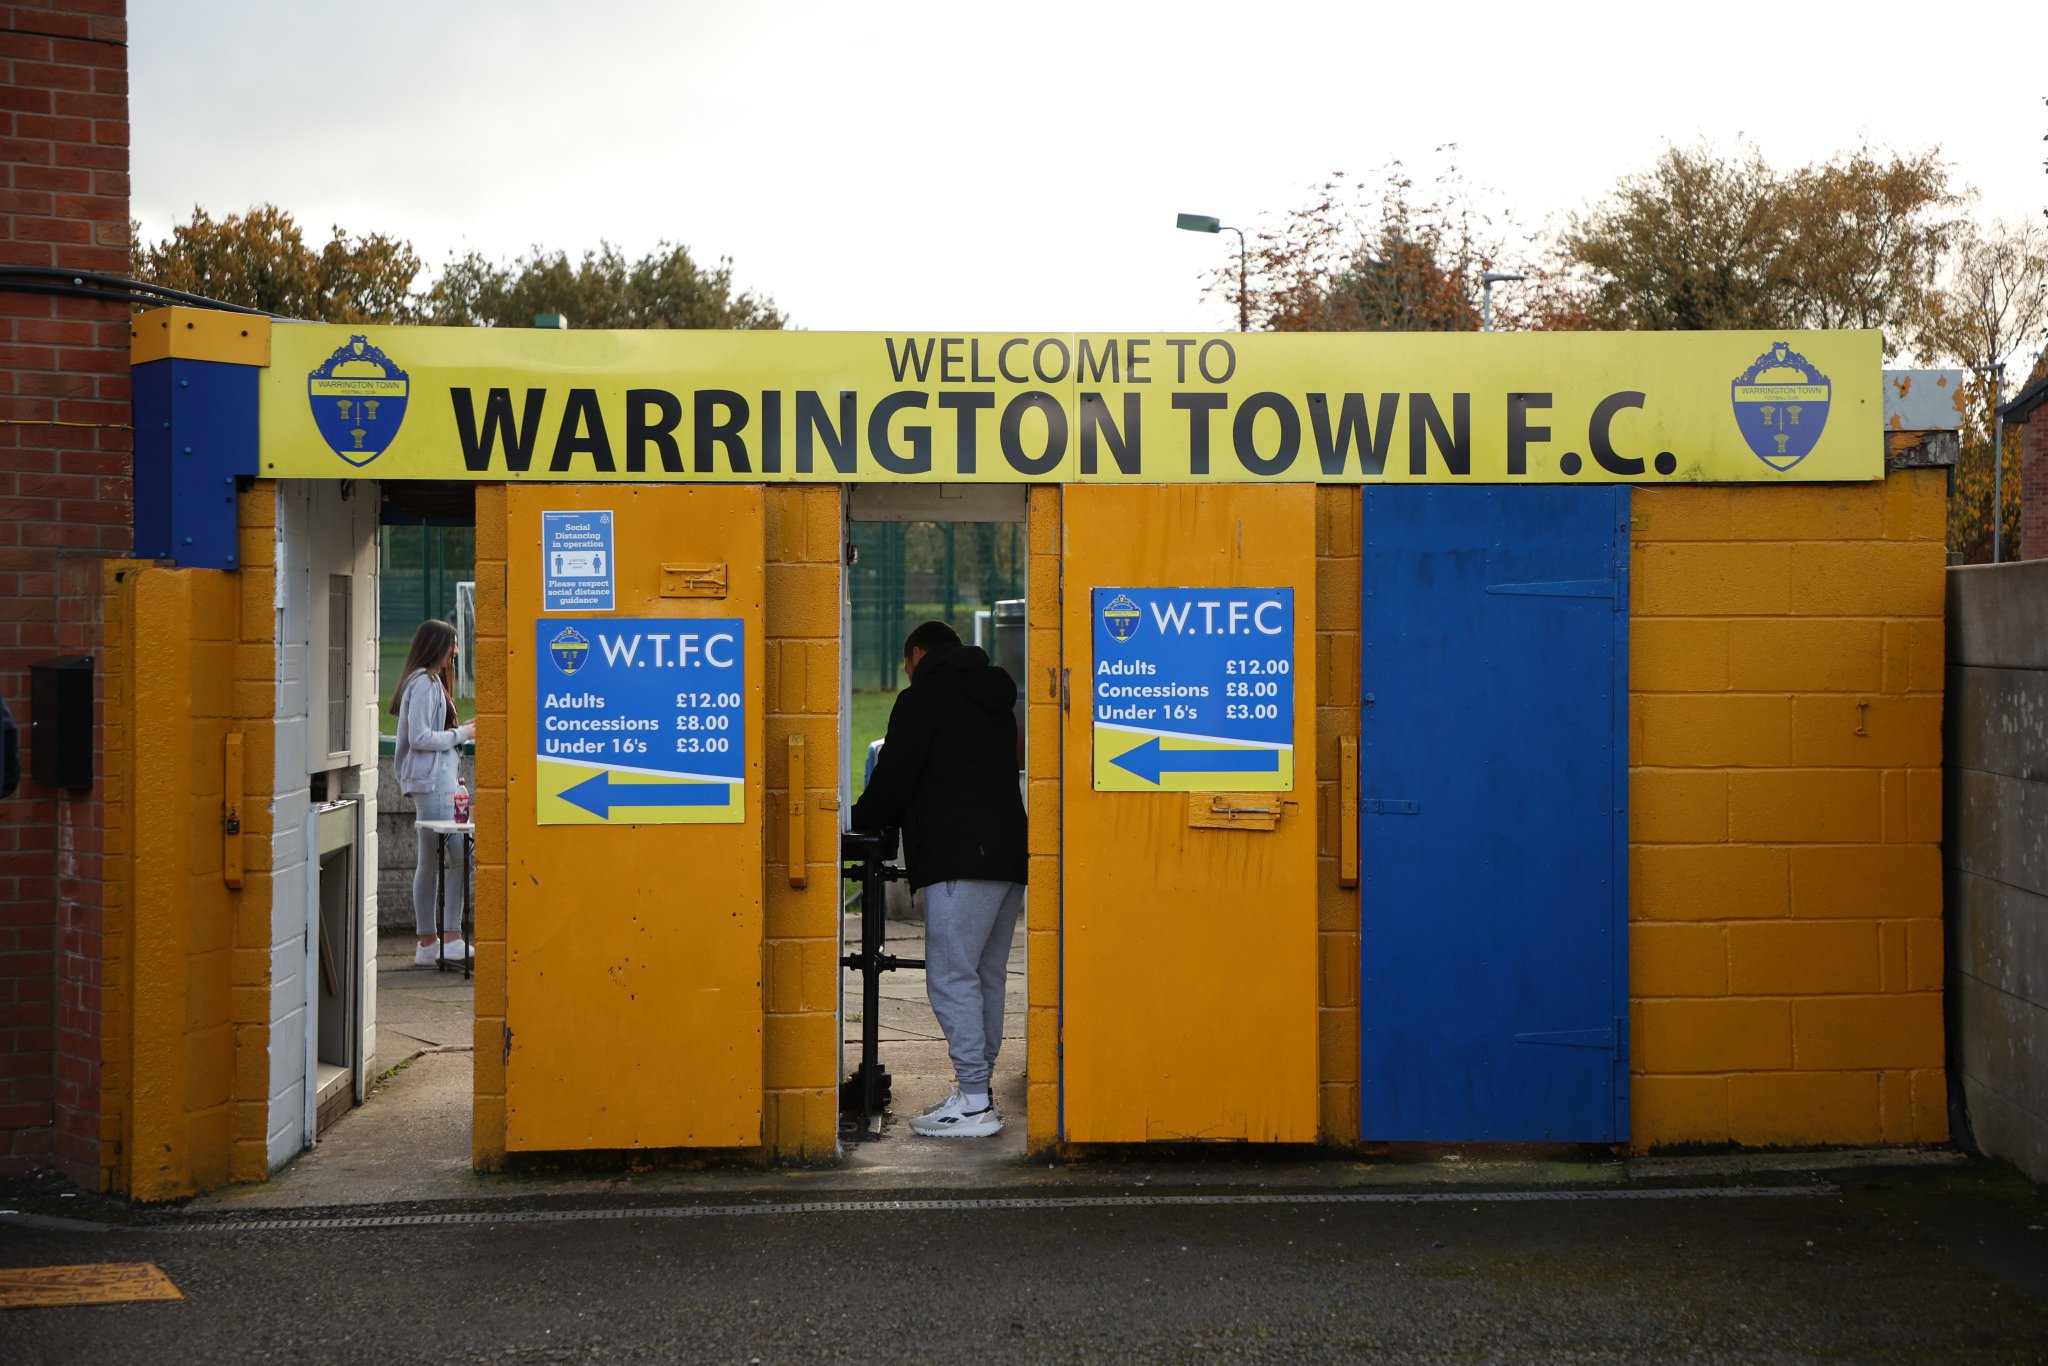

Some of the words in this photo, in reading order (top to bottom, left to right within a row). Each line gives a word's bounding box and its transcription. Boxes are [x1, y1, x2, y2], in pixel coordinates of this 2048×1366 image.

[885, 338, 1152, 384] WELCOME
[1166, 338, 1236, 384] TO
[319, 381, 373, 389] WARRINGTON
[376, 381, 400, 389] TOWN
[1741, 387, 1796, 395] WARRINGTON
[450, 387, 1141, 476] WARRINGTON
[1171, 391, 1470, 476] TOWN
[1507, 391, 1677, 476] F.C.
[565, 523, 591, 531] Social
[555, 532, 601, 540] Distancing
[563, 540, 604, 549] operation
[578, 580, 609, 588] respect
[560, 597, 598, 605] guidance
[1150, 601, 1283, 635] W.T.F.C
[598, 633, 734, 668] W.T.F.C
[1097, 659, 1157, 675] Adults
[1226, 659, 1289, 675] £12.00
[1098, 682, 1209, 698] Concessions
[1226, 682, 1278, 697] £8.00
[544, 693, 605, 709] Adults
[676, 693, 741, 708] £12.00
[1098, 704, 1157, 720] Under
[1163, 704, 1198, 720] 16's
[1226, 704, 1278, 720] £3.00
[545, 715, 660, 731] Concessions
[676, 715, 729, 731] £8.00
[545, 738, 606, 754] Under
[612, 738, 648, 753] 16's
[676, 737, 729, 753] £3.00
